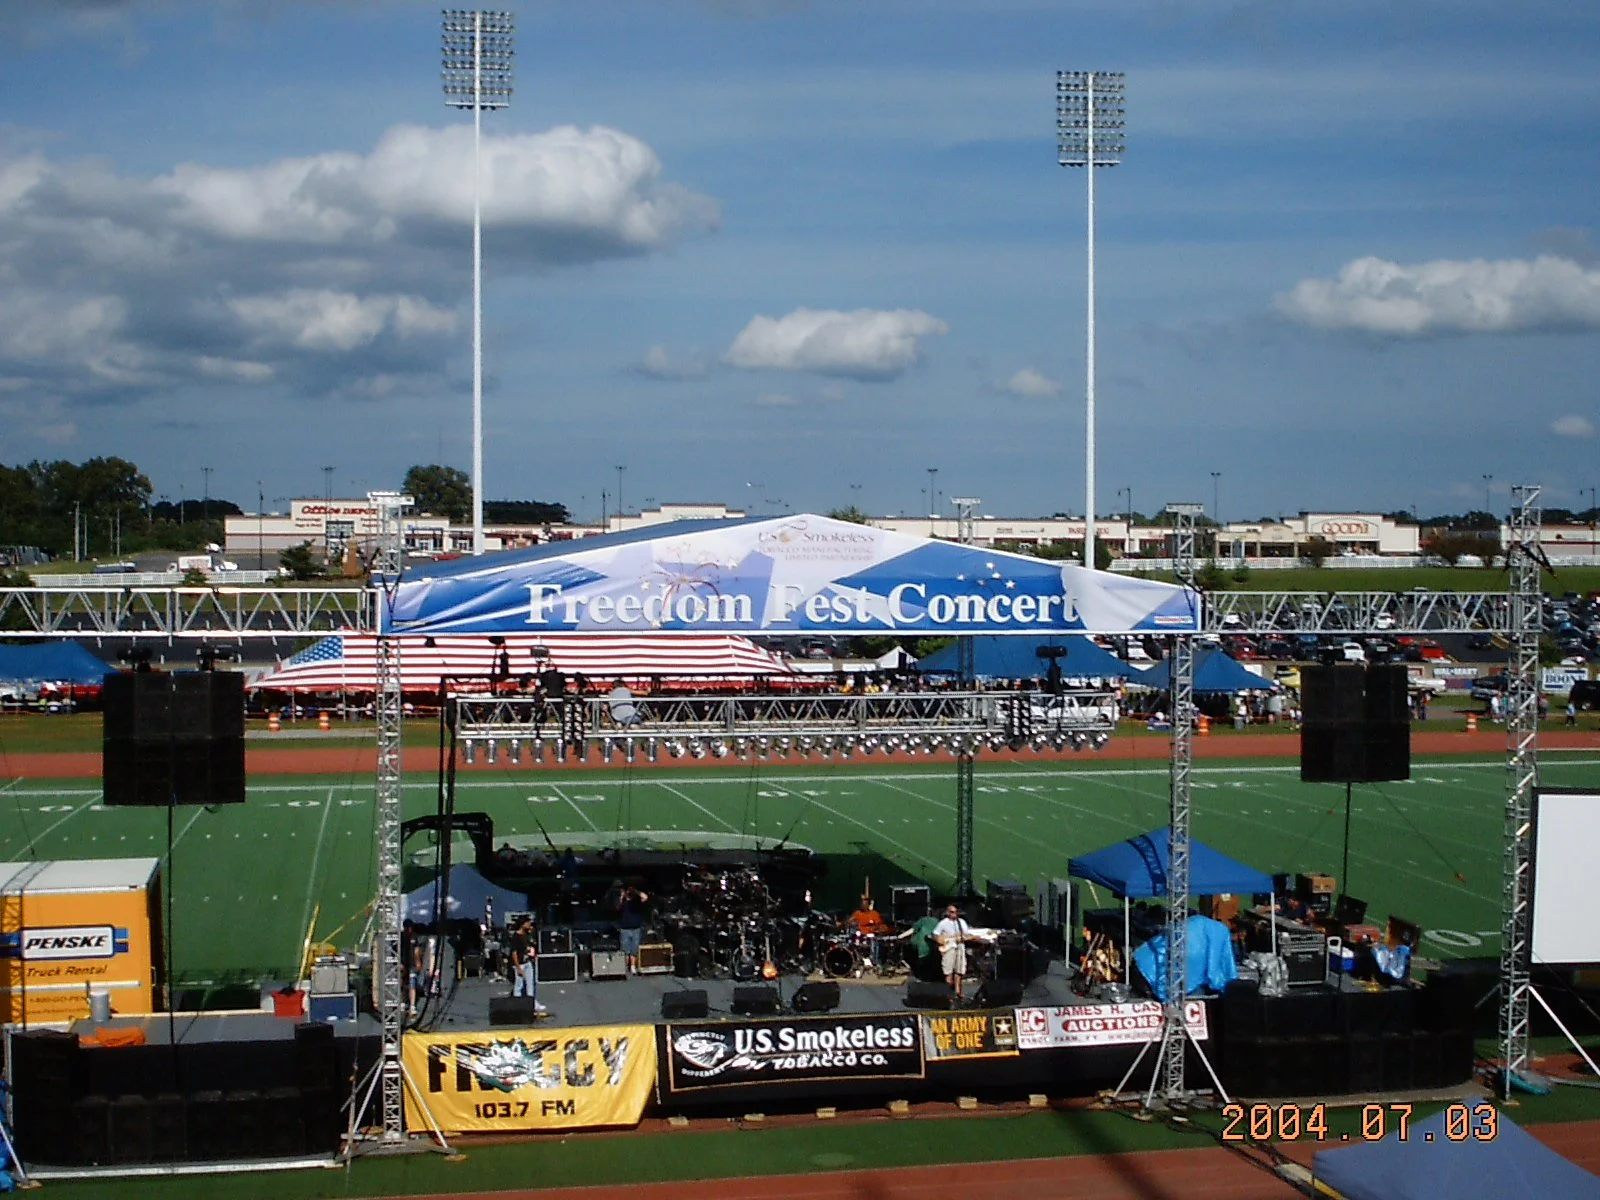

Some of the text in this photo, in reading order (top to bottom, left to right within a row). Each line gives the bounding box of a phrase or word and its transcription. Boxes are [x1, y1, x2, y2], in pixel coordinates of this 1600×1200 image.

[524, 582, 1081, 625] Freedom Fest Concert
[25, 935, 108, 951] PENSKE
[26, 965, 108, 978] Truck Rental
[1055, 1003, 1102, 1017] JAMES
[931, 1015, 988, 1034] AN ARMY
[1067, 1016, 1161, 1032] AUCTIONS
[734, 1023, 914, 1055] U.S. Smokeless
[936, 1031, 984, 1050] OF ONE
[772, 1052, 888, 1070] TOBACCO CO.
[475, 1098, 576, 1119] 103.7 FM
